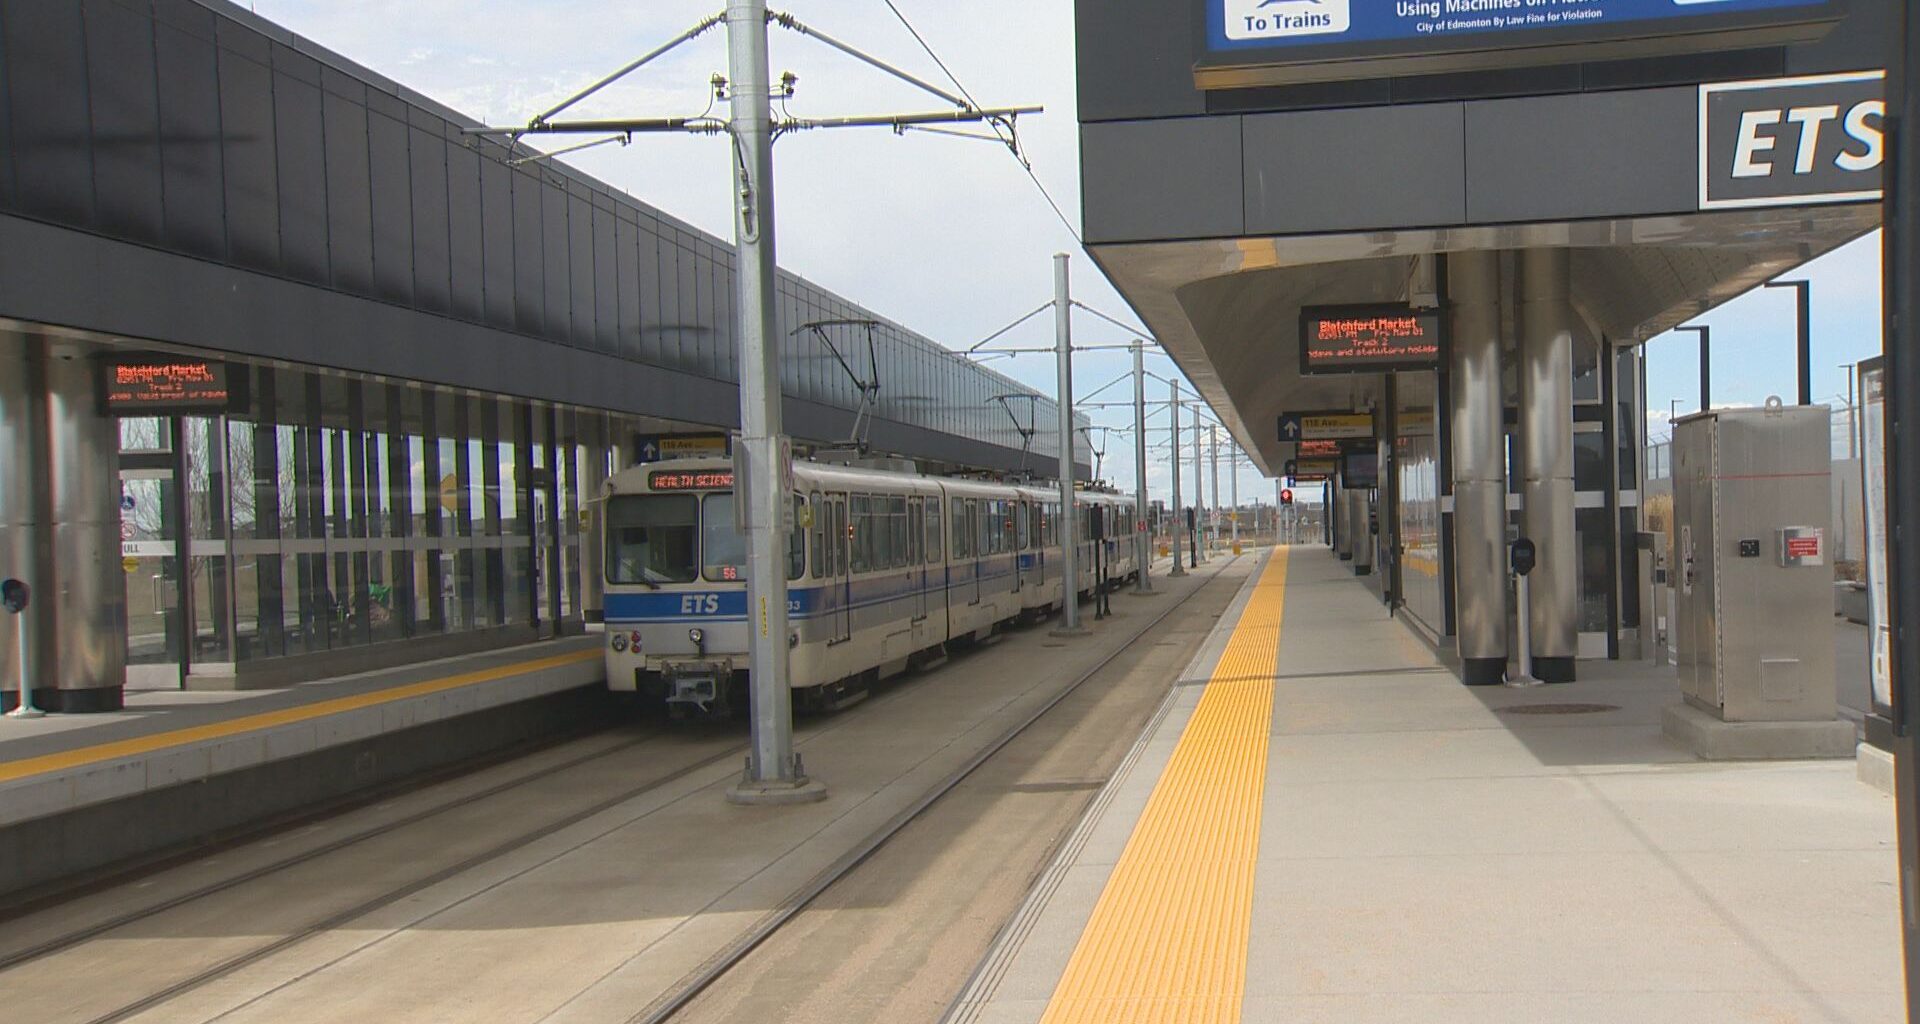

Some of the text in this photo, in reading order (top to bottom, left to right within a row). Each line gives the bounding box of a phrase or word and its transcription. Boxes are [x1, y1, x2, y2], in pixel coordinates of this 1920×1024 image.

[1396, 1, 1440, 18] Using
[1446, 0, 1520, 14] Machines
[1244, 11, 1331, 31] To Trains
[1416, 9, 1603, 33] City of Edmonton By Law Fine for Violation
[1732, 100, 1885, 178] ETS
[1320, 317, 1416, 332] Blatchford Market
[1352, 339, 1378, 347] Track
[117, 364, 207, 377] Blatchford Market
[723, 567, 737, 580] 56
[681, 594, 719, 614] ETS
